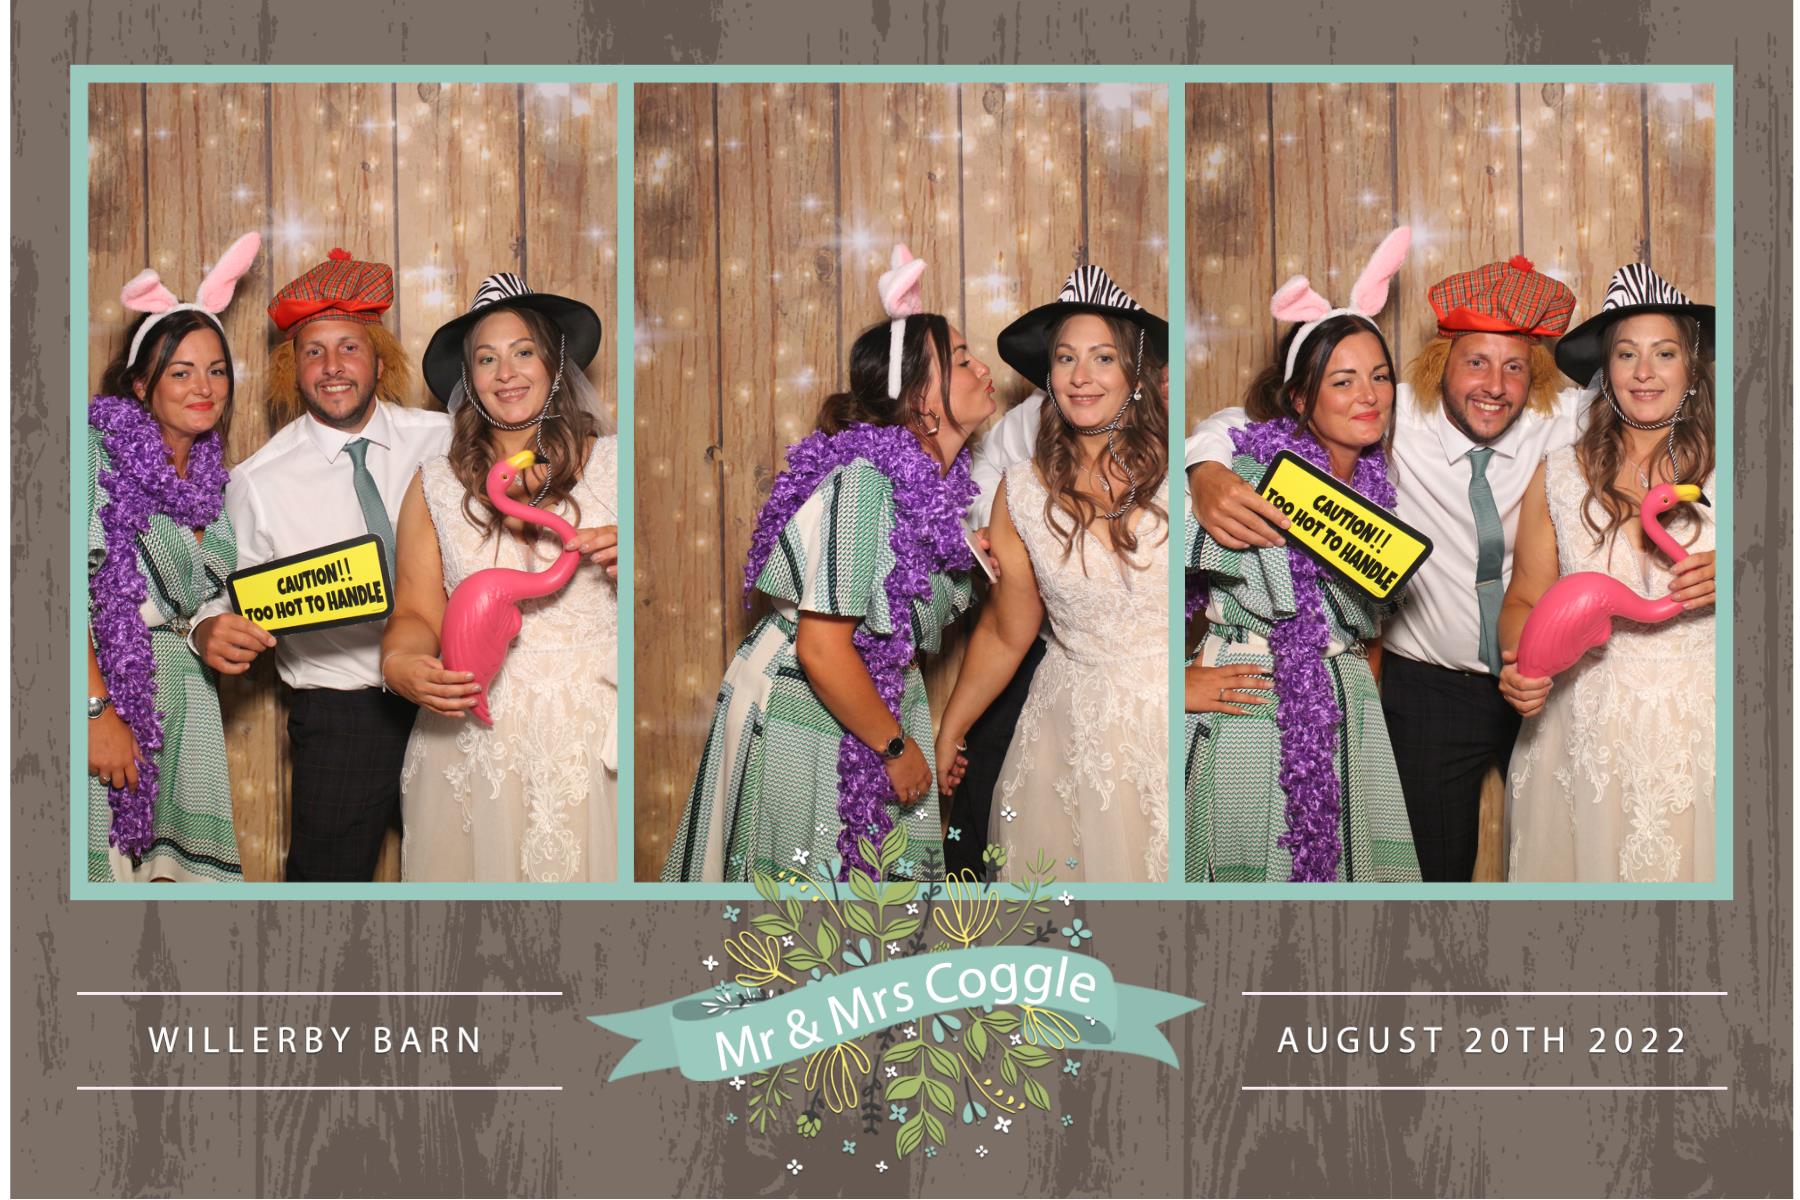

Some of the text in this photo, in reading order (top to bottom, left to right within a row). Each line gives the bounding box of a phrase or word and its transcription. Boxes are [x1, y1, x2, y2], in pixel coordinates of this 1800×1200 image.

[1266, 488, 1399, 592] TOO HOT TO HANDLE
[1312, 495, 1393, 554] CAUTION!!
[244, 580, 384, 622] TOO HOT TO HANDLE
[277, 557, 353, 595] CAUTION!!
